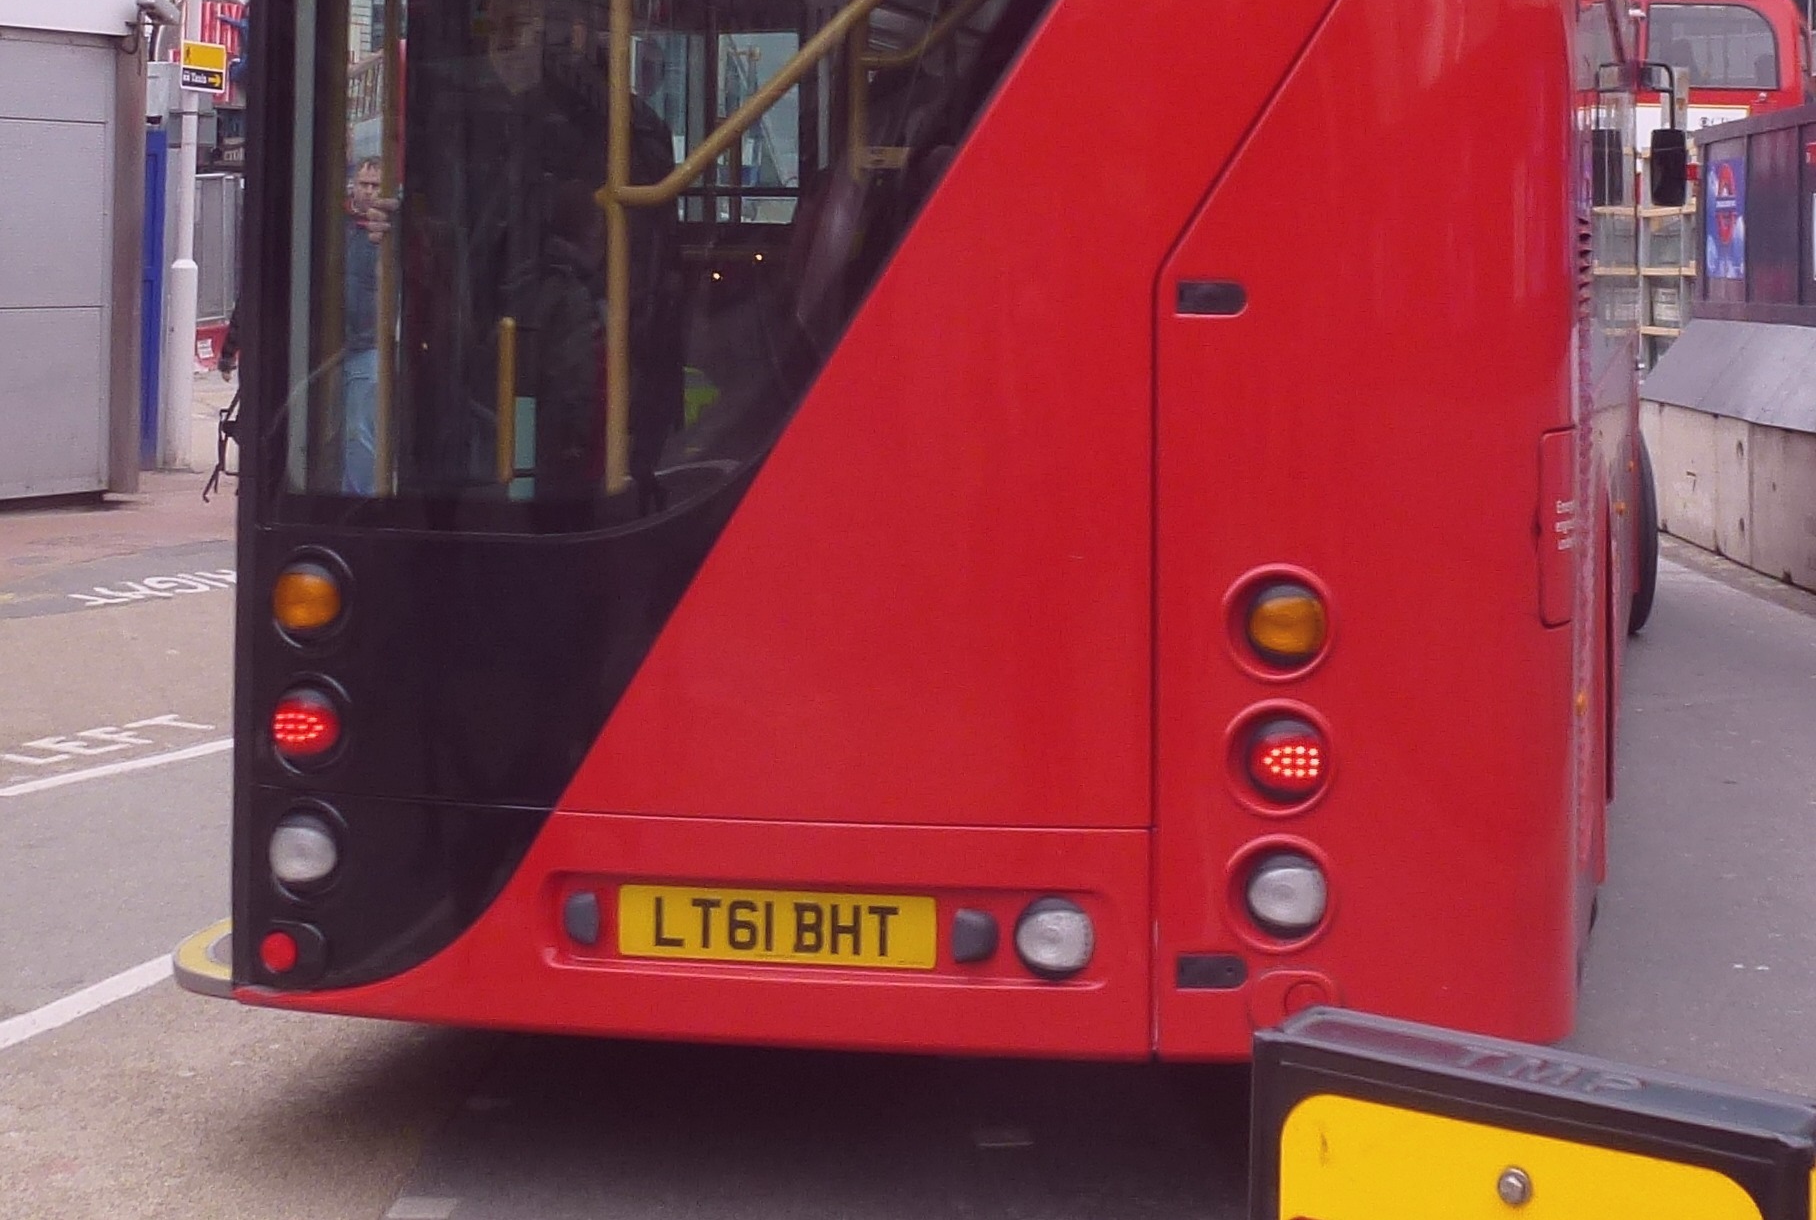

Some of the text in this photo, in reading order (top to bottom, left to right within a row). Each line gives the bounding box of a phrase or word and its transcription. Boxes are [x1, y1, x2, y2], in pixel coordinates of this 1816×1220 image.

[0, 713, 217, 765] LEFT
[652, 895, 900, 959] LT61 BHT
[1462, 1044, 1646, 1093] TMP
